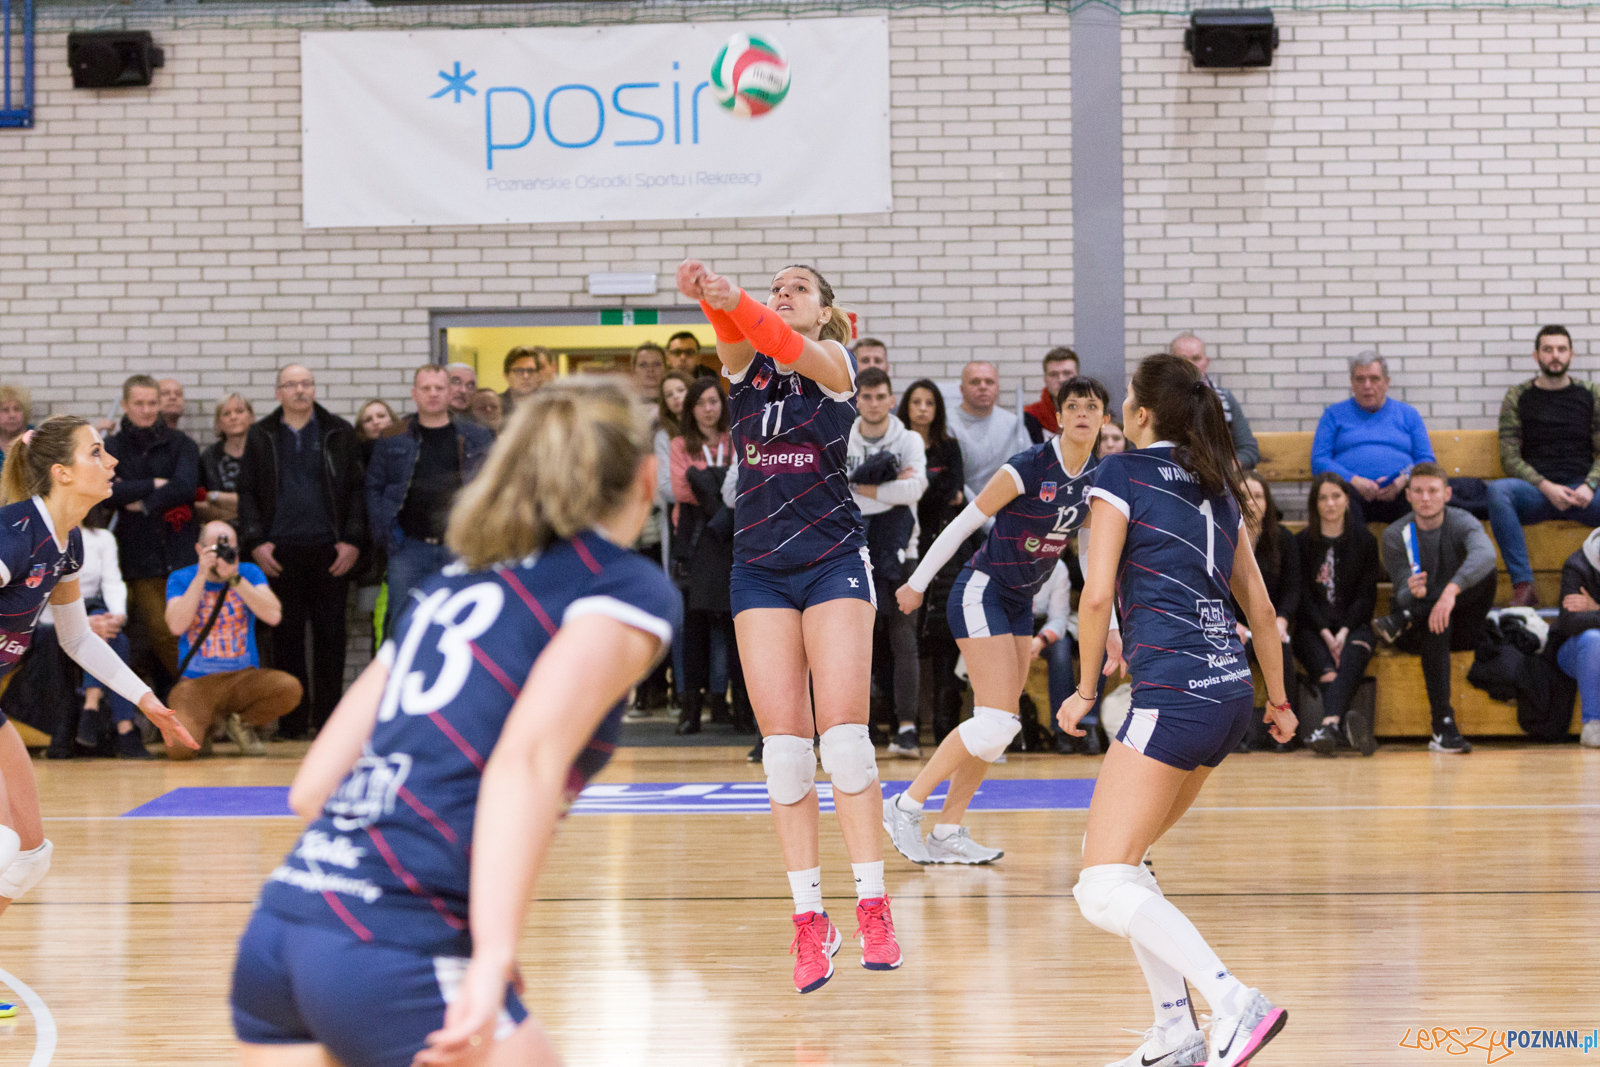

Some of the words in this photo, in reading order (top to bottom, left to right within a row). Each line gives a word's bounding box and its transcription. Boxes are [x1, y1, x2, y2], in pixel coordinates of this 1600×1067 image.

[485, 61, 709, 170] posir
[486, 176, 572, 191] Poznańskie
[574, 174, 632, 190] Ośrodki
[634, 172, 686, 189] Sportu
[695, 171, 762, 187] Rekreacji
[761, 453, 814, 467] Energa
[1052, 505, 1079, 532] 12
[1198, 499, 1215, 577] 1
[377, 581, 505, 722] 13
[1188, 676, 1221, 689] Dopisz
